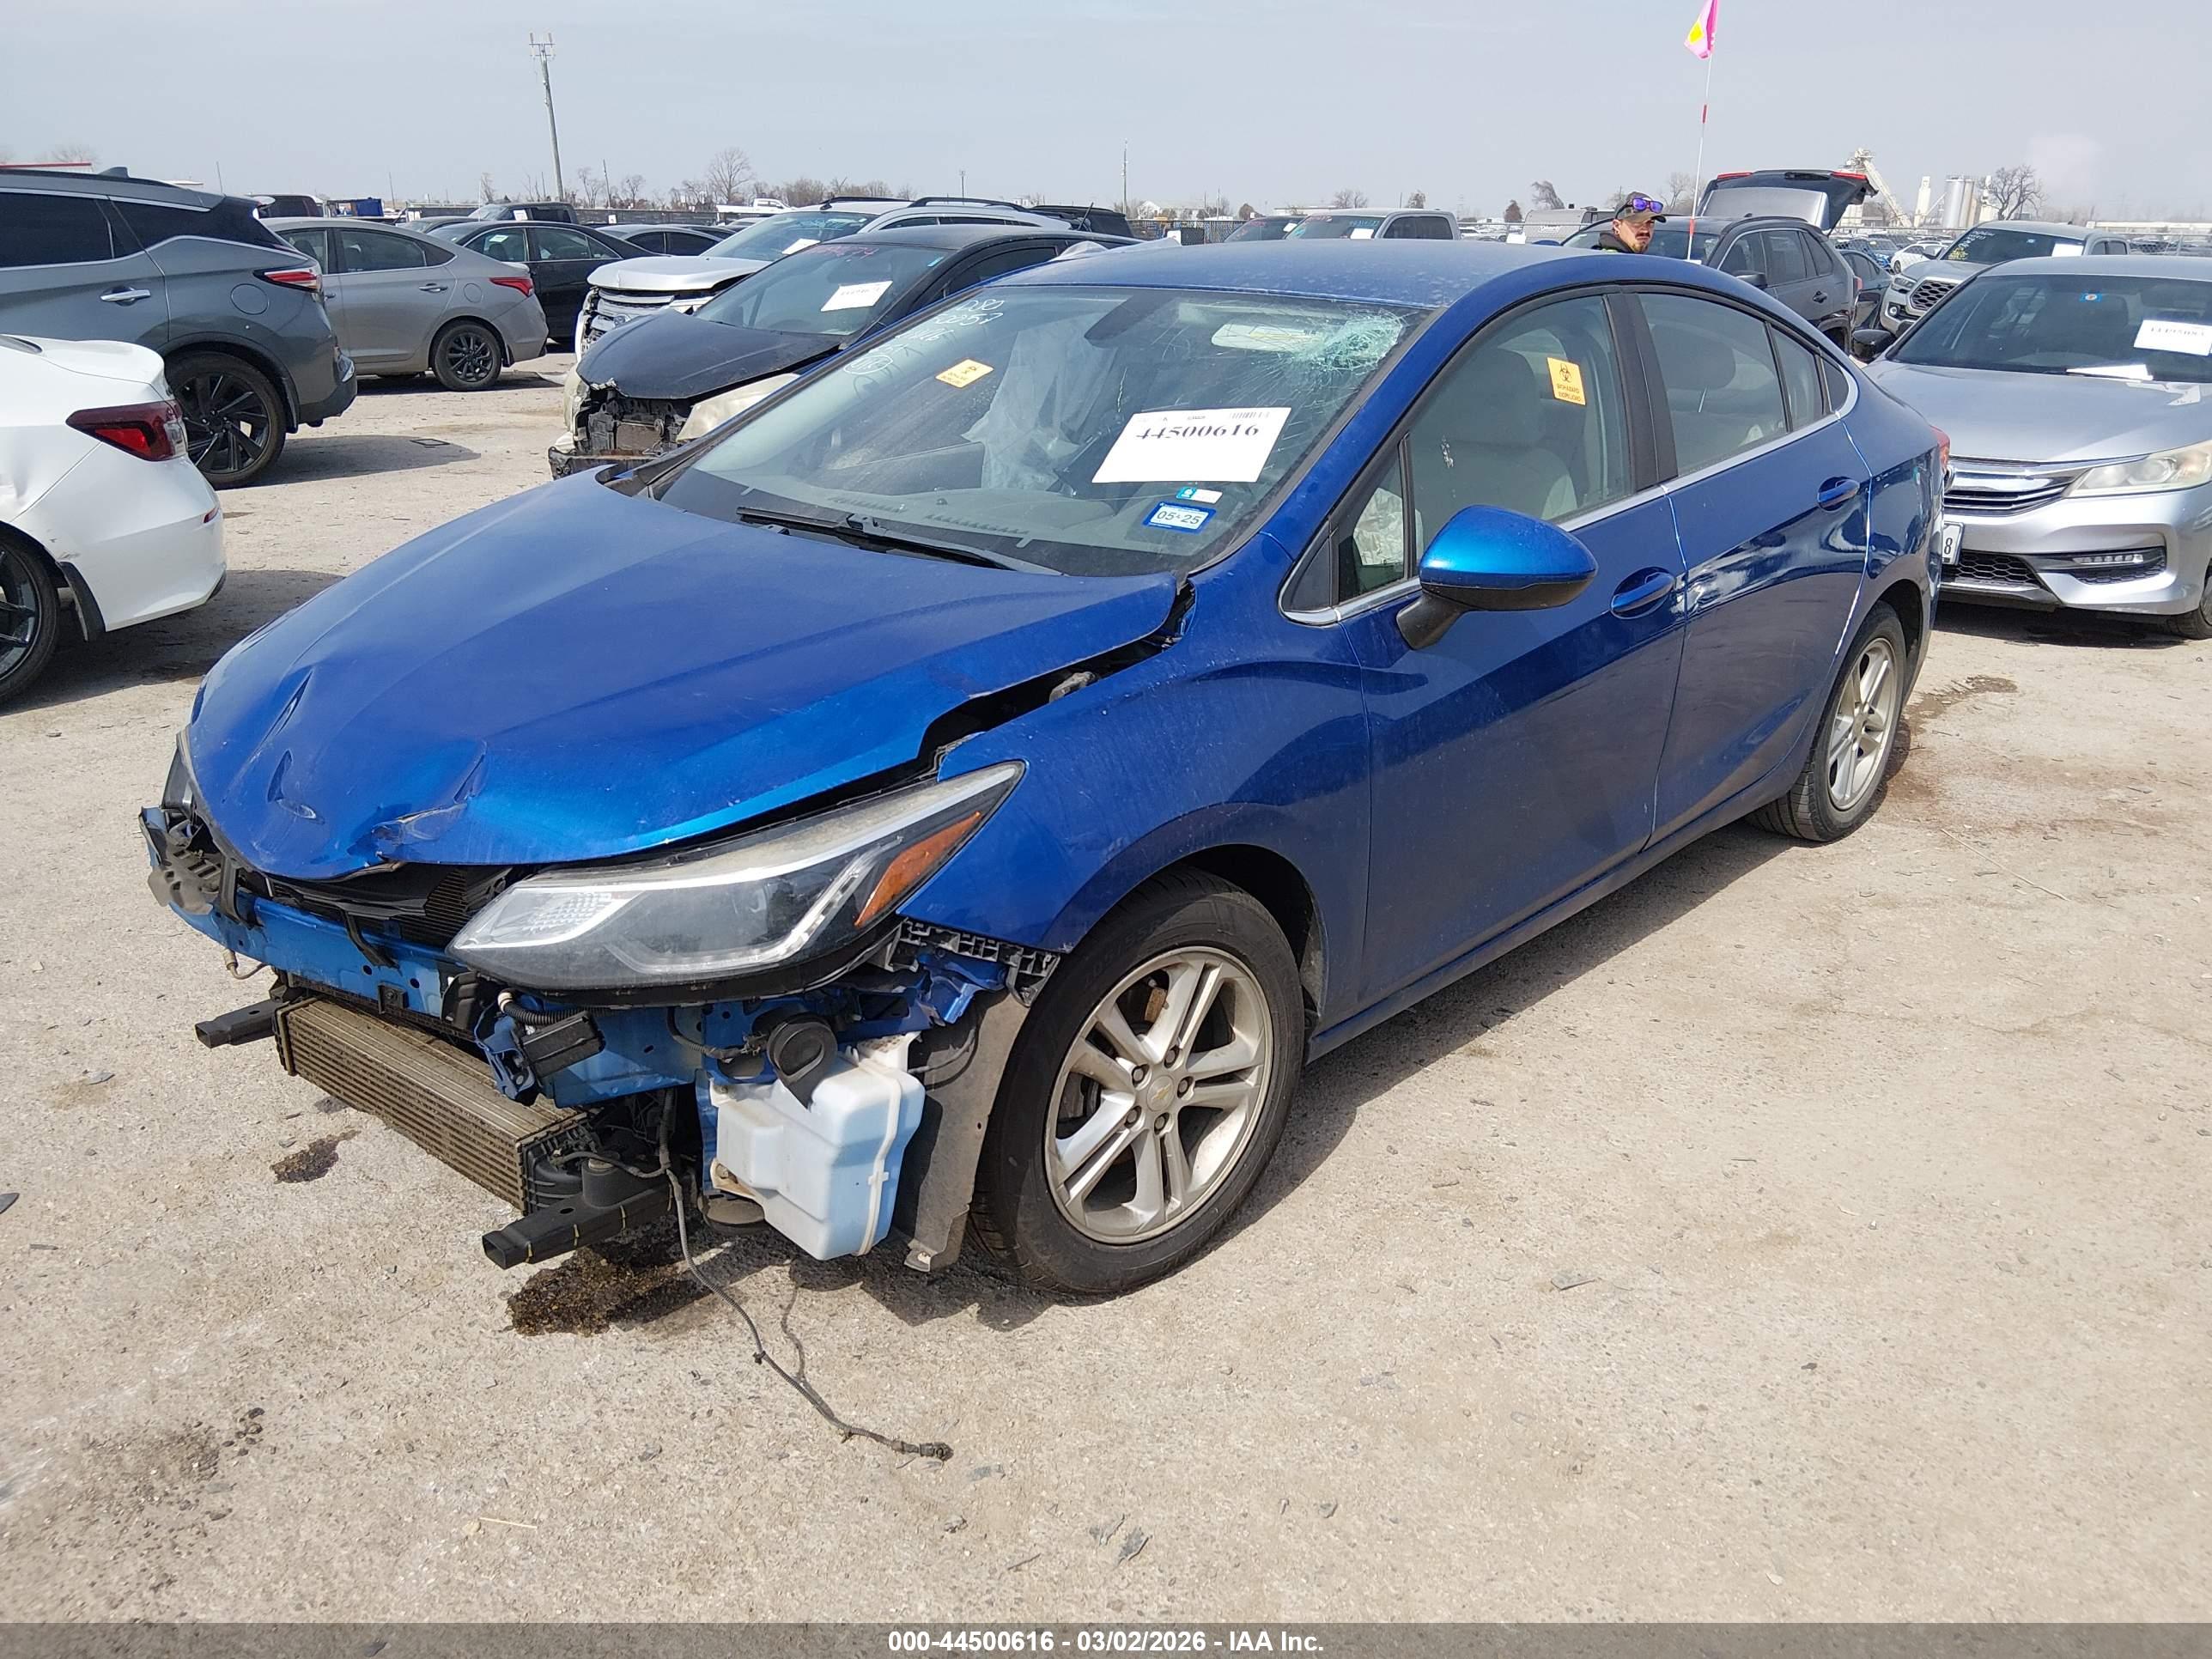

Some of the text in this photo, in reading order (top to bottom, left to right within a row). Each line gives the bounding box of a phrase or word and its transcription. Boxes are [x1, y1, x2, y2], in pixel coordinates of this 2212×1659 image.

[1136, 424, 1259, 439] 44500616
[1157, 511, 1200, 525] 05 25
